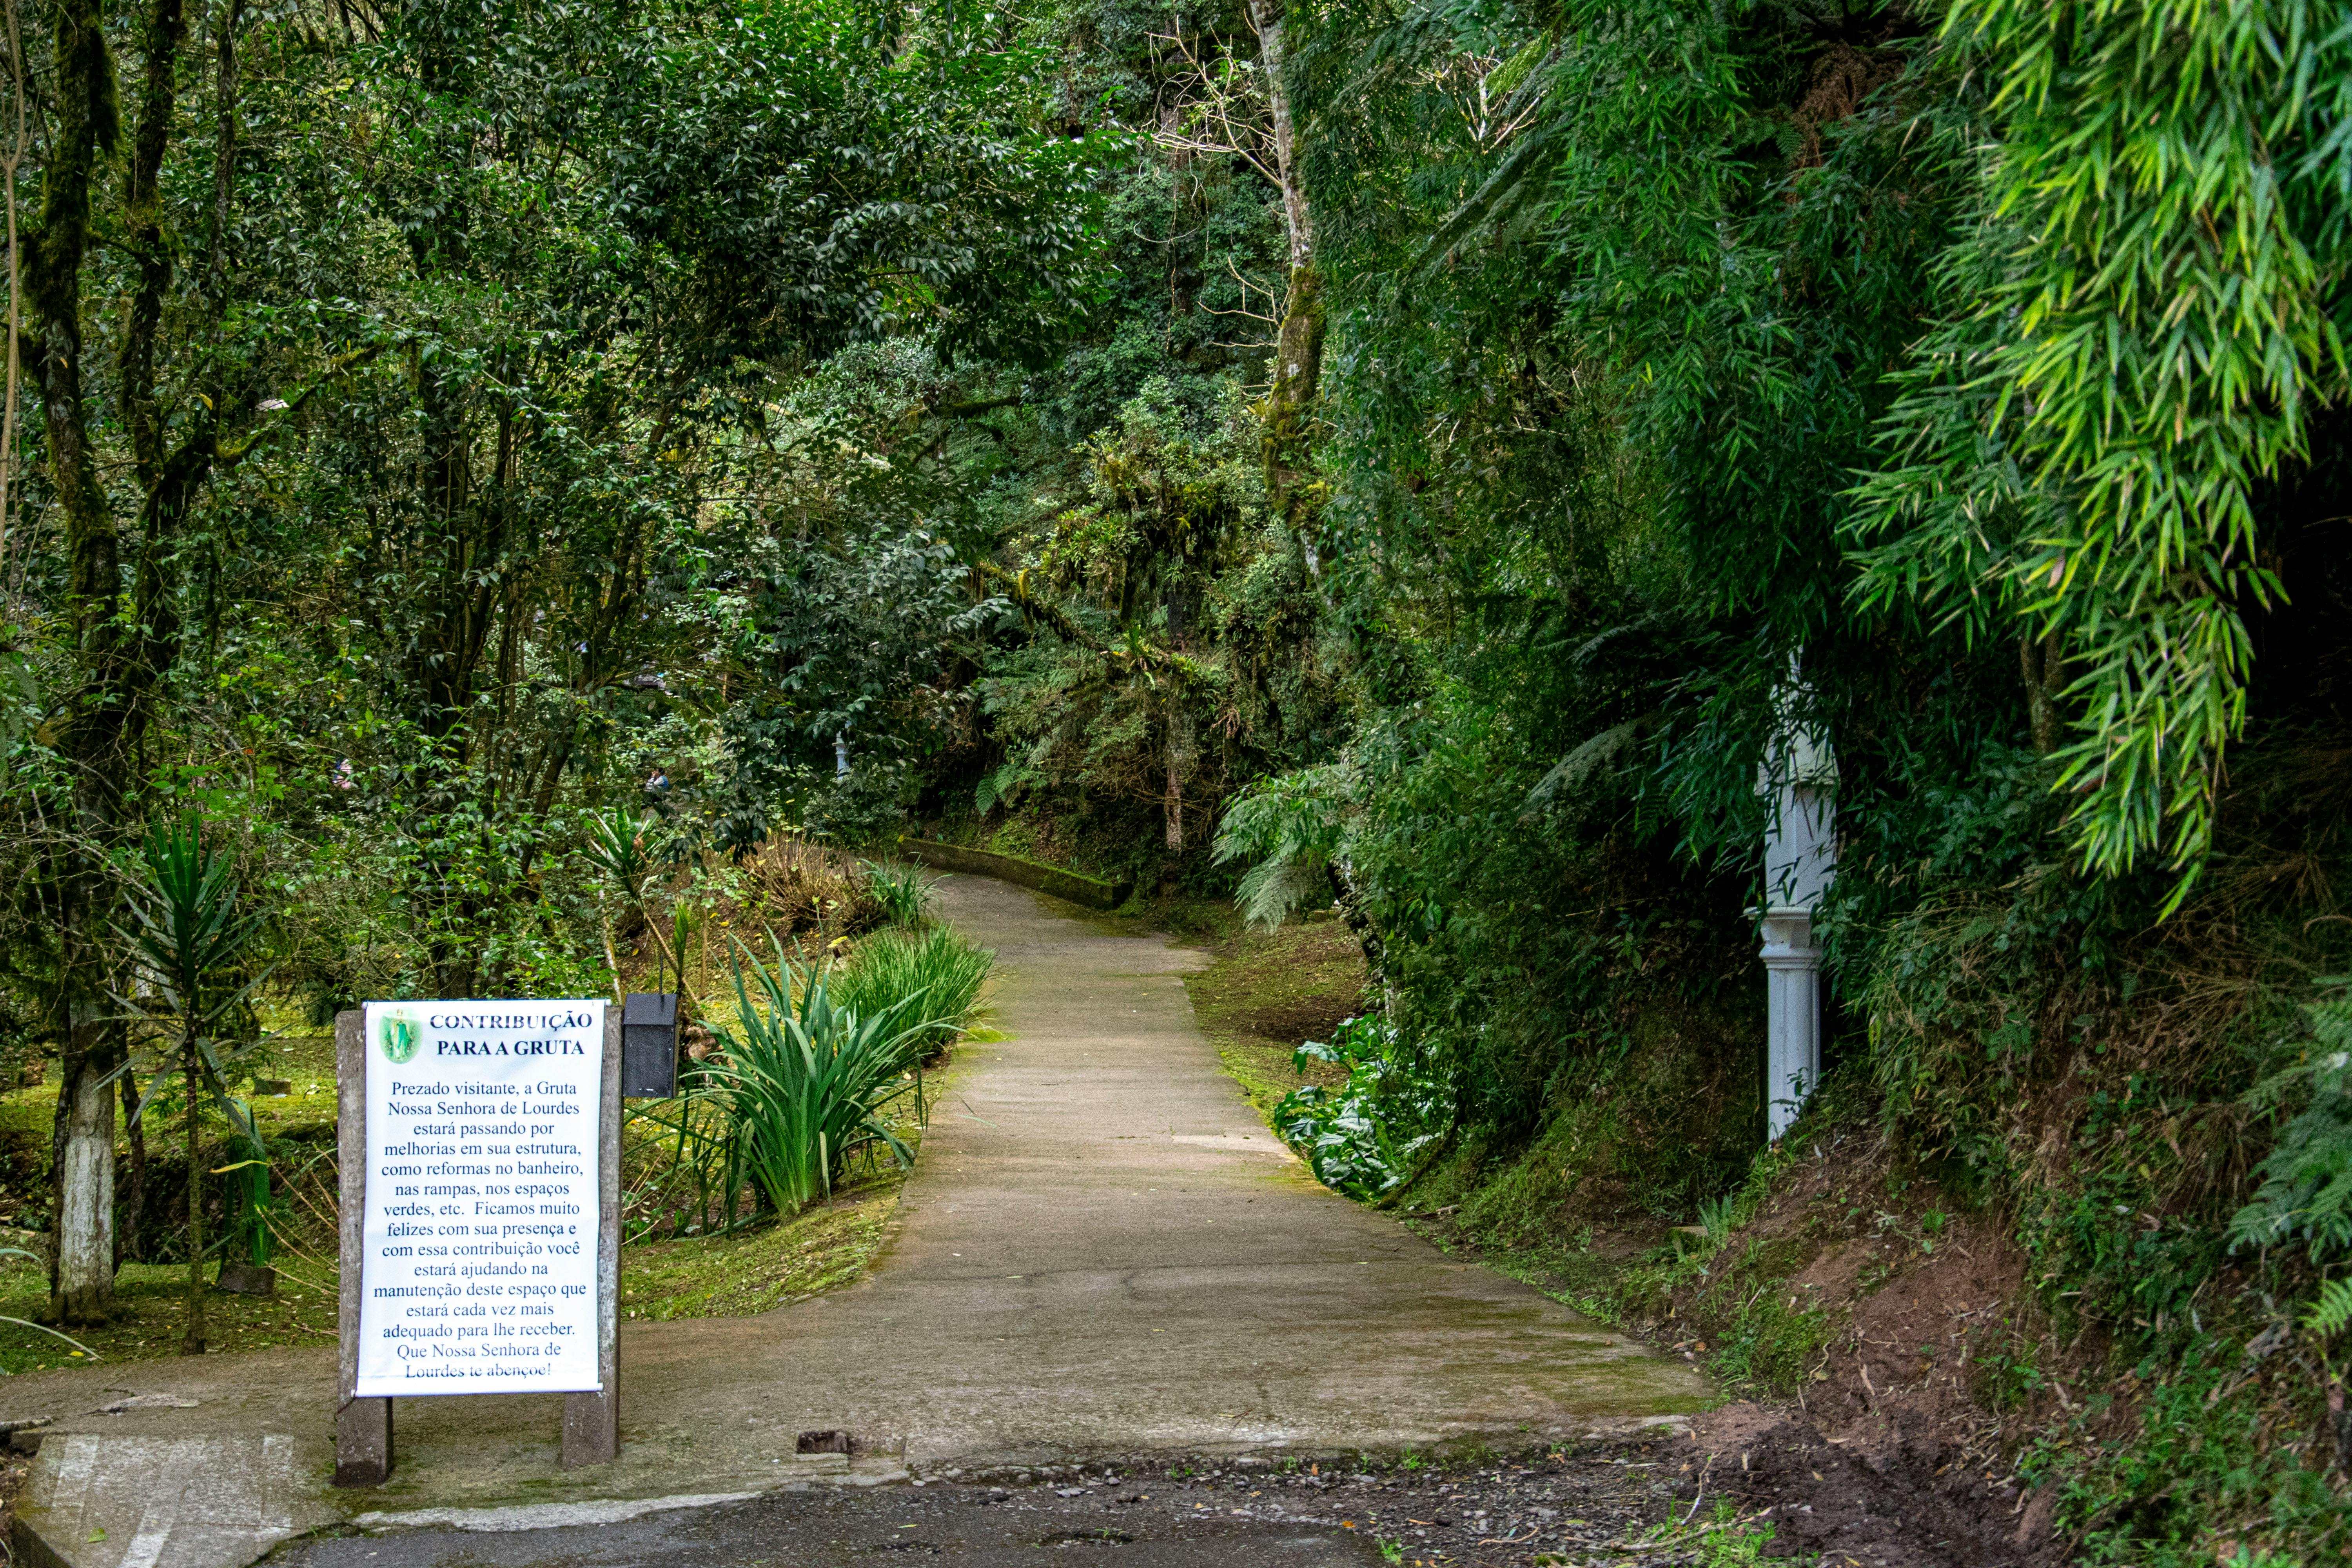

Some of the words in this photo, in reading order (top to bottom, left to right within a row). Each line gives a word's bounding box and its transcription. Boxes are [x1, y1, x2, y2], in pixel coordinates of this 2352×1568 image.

[430, 1010, 592, 1032] CONTRIBUIÇÃO
[437, 1040, 492, 1055] PARA
[495, 1041, 509, 1055] A
[514, 1040, 584, 1056] GRUTA
[392, 1081, 450, 1095] Prezado
[455, 1081, 519, 1096] visitante,
[524, 1085, 532, 1094] a
[537, 1081, 577, 1094] Gruta
[388, 1102, 432, 1115] Nossa
[437, 1101, 496, 1115] Senhora
[501, 1101, 517, 1114] de
[523, 1101, 579, 1114] Lourdes
[414, 1121, 456, 1135] estará
[461, 1121, 526, 1138] passando
[531, 1125, 555, 1138] por
[384, 1141, 456, 1156] melhorias
[461, 1145, 482, 1155] em
[487, 1145, 511, 1154] sua
[515, 1143, 581, 1156] estrutura,
[381, 1166, 422, 1176] como
[426, 1161, 490, 1175] reformas
[495, 1165, 513, 1174] no
[518, 1161, 583, 1176] banheiro,
[395, 1186, 419, 1196] nas
[424, 1185, 480, 1198] rampas,
[486, 1185, 510, 1194] nos
[515, 1185, 569, 1198] espaços
[384, 1202, 434, 1218] verdes,
[440, 1204, 464, 1215] etc.
[475, 1201, 535, 1215] Ficamos
[540, 1201, 580, 1214] muito
[387, 1222, 433, 1236] felizes
[438, 1226, 469, 1235] com
[474, 1225, 498, 1235] sua
[503, 1225, 564, 1238] presença
[568, 1225, 576, 1234] e
[382, 1247, 413, 1257] com
[418, 1246, 448, 1256] essa
[453, 1241, 543, 1258] contribuição
[547, 1241, 580, 1254] você
[414, 1262, 456, 1276] estará
[461, 1261, 527, 1279] ajudando
[532, 1265, 548, 1274] na
[374, 1283, 461, 1299] manutenção
[466, 1282, 503, 1296] deste
[508, 1285, 556, 1299] espaço
[561, 1285, 586, 1298] que
[406, 1303, 448, 1317] estará
[453, 1302, 486, 1316] cada
[491, 1306, 515, 1315] vez
[521, 1301, 554, 1315] mais
[383, 1323, 452, 1341] adequado
[457, 1327, 488, 1340] para
[494, 1323, 515, 1336] lhe
[520, 1322, 575, 1335] receber.
[397, 1345, 427, 1360] Que
[432, 1344, 476, 1357] Nossa
[481, 1343, 540, 1356] Senhora
[544, 1342, 561, 1355] de
[405, 1364, 465, 1378] Lourdes
[470, 1367, 482, 1377] te
[487, 1363, 550, 1379] abençoe!
